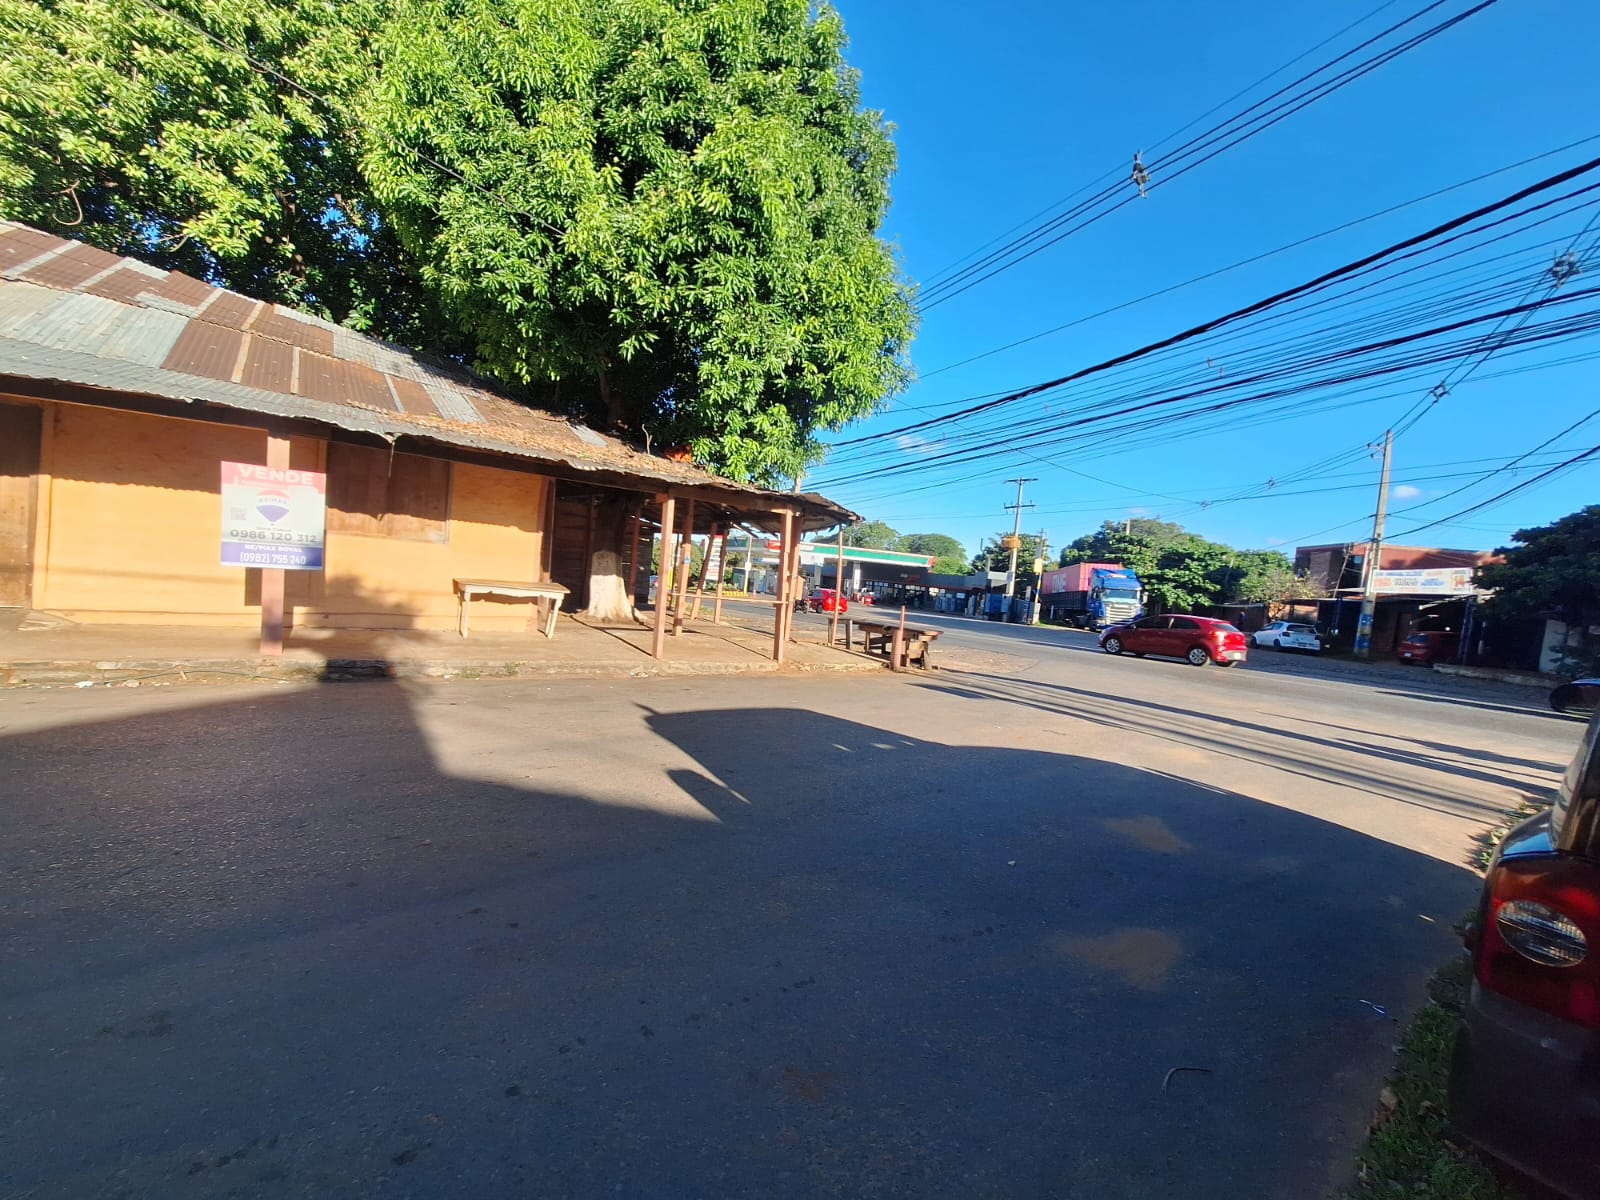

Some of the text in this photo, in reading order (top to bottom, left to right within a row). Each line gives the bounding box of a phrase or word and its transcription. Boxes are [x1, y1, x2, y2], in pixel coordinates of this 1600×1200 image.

[238, 464, 313, 484] VENDE
[230, 529, 266, 540] 0986
[271, 531, 293, 542] 120
[272, 553, 288, 564] 755
